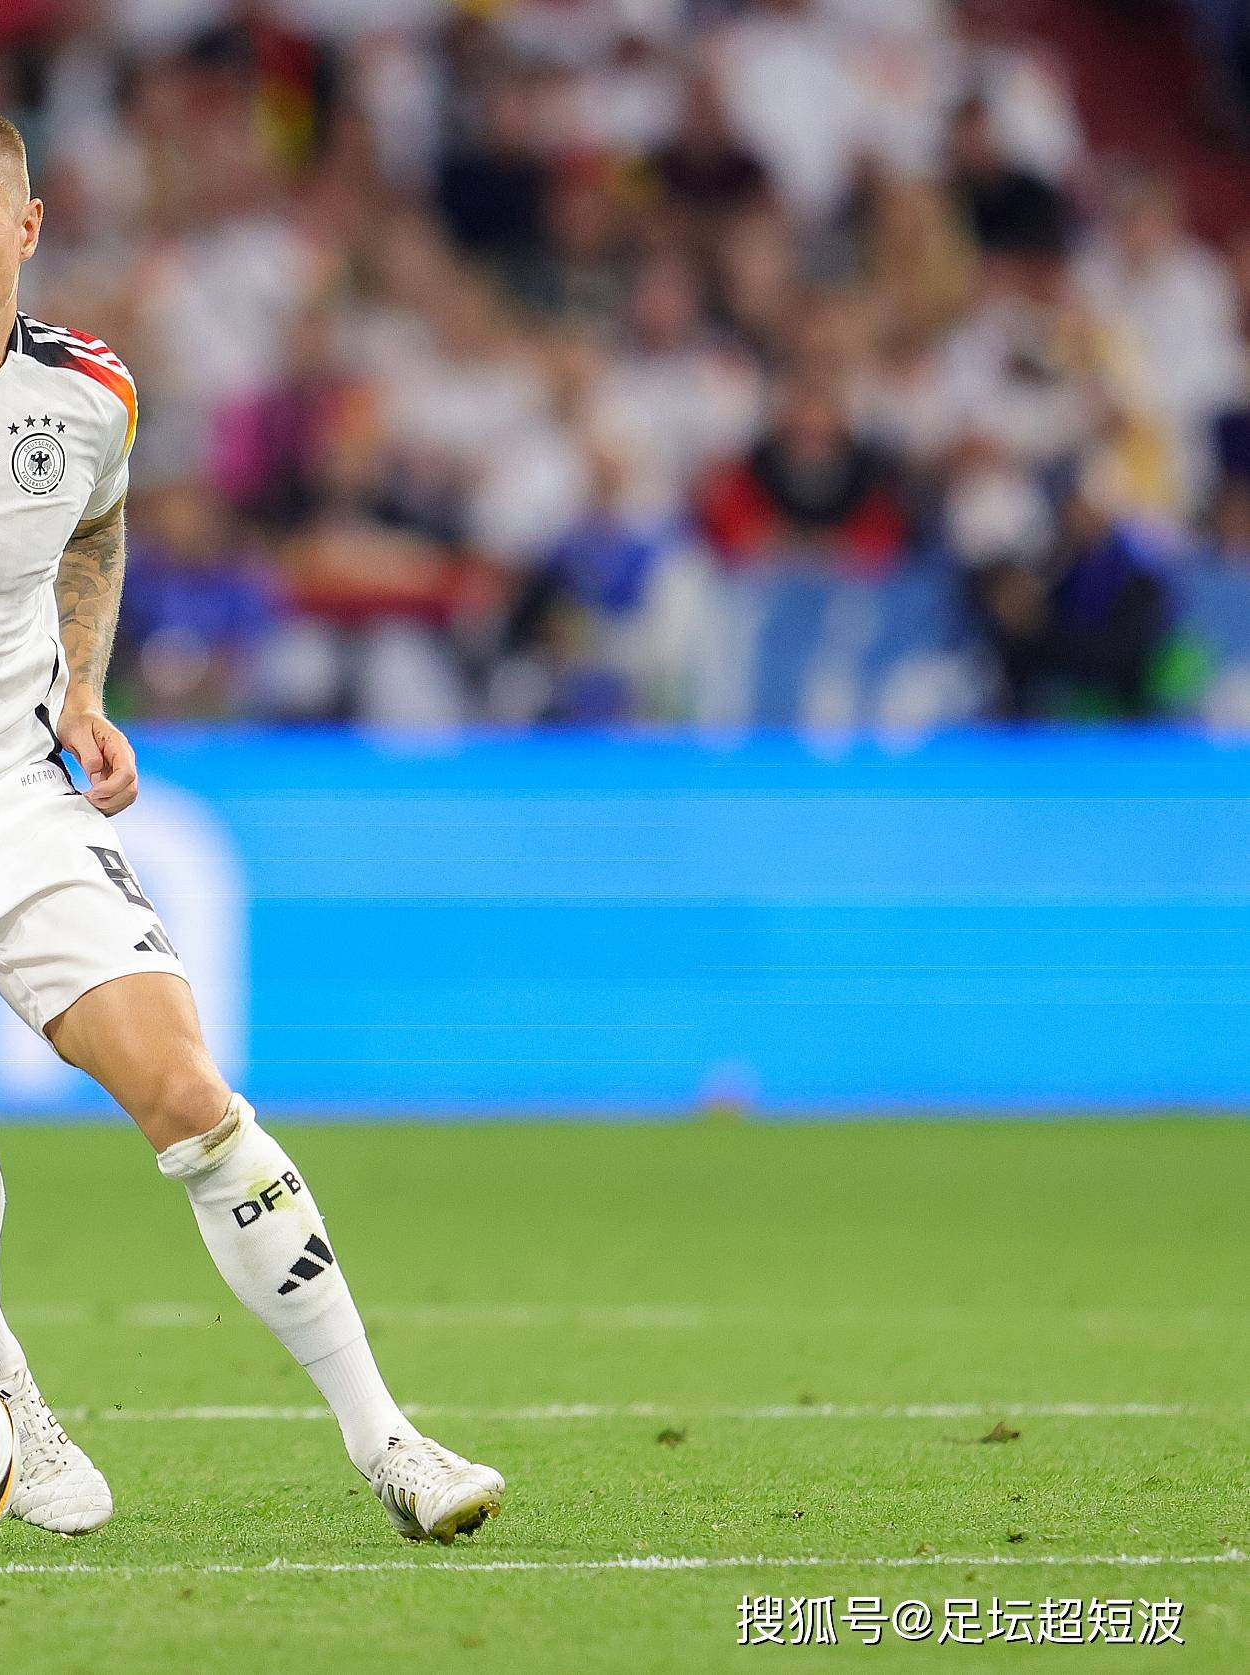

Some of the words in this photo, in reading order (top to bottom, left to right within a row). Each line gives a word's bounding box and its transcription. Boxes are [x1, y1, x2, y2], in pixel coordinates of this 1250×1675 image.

[23, 440, 55, 453] DEUTSCHER
[85, 845, 155, 912] 8
[231, 1170, 302, 1228] DFB
